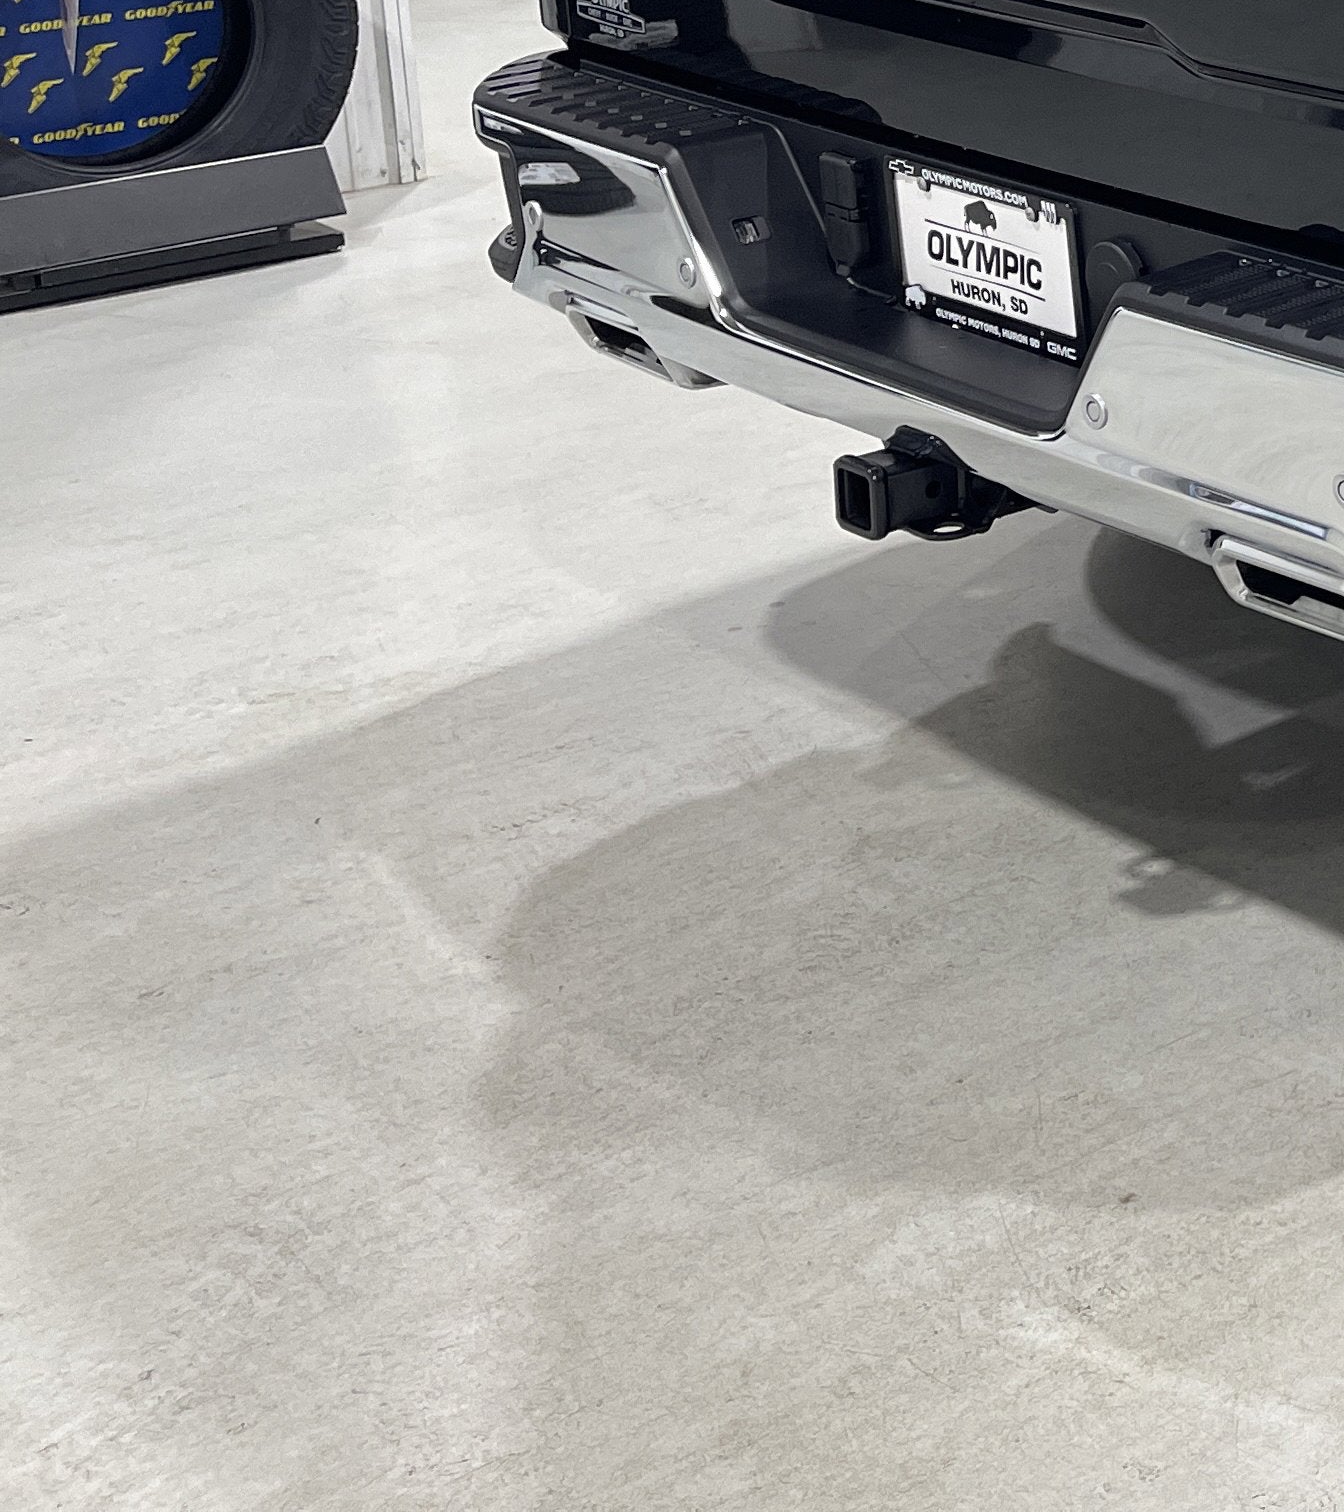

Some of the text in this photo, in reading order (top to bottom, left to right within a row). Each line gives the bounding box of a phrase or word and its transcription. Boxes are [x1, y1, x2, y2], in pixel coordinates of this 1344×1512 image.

[125, 0, 214, 21] GOODYEAR
[33, 121, 125, 145] GOODYEAR
[921, 168, 1027, 207] OLYMPICMOTORS.COM
[927, 229, 1042, 291] OLYMPIC
[951, 278, 1028, 315] HURON, SD
[936, 307, 1040, 349] OLYMPIC MOTORS, HURON SD
[1047, 342, 1077, 360] GMC
